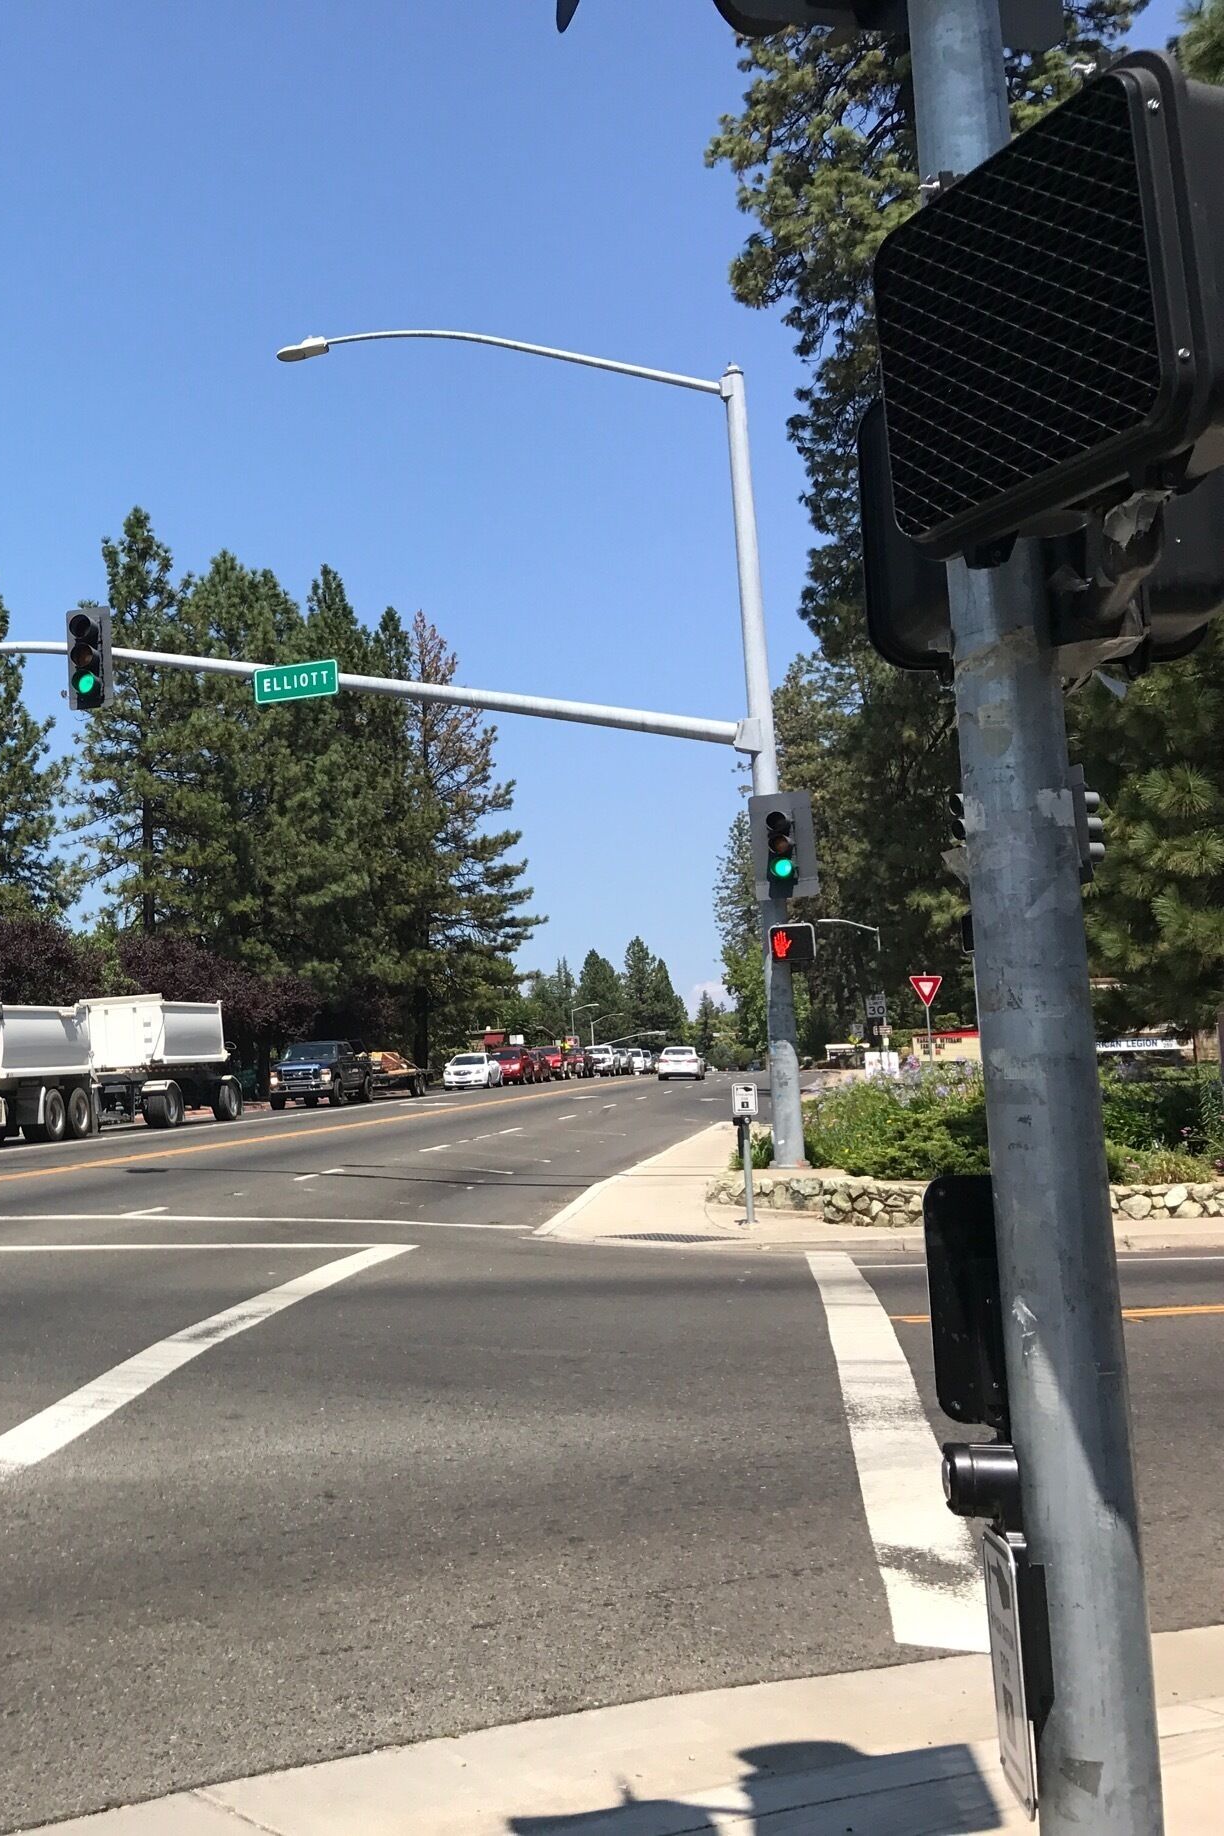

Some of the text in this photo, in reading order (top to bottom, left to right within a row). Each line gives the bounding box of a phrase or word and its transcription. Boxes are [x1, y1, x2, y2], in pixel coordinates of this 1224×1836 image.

[263, 671, 328, 692] ELLIOTT
[869, 1006, 885, 1015] 30
[1095, 1040, 1122, 1048] RICAN
[1126, 1038, 1158, 1048] LEGION
